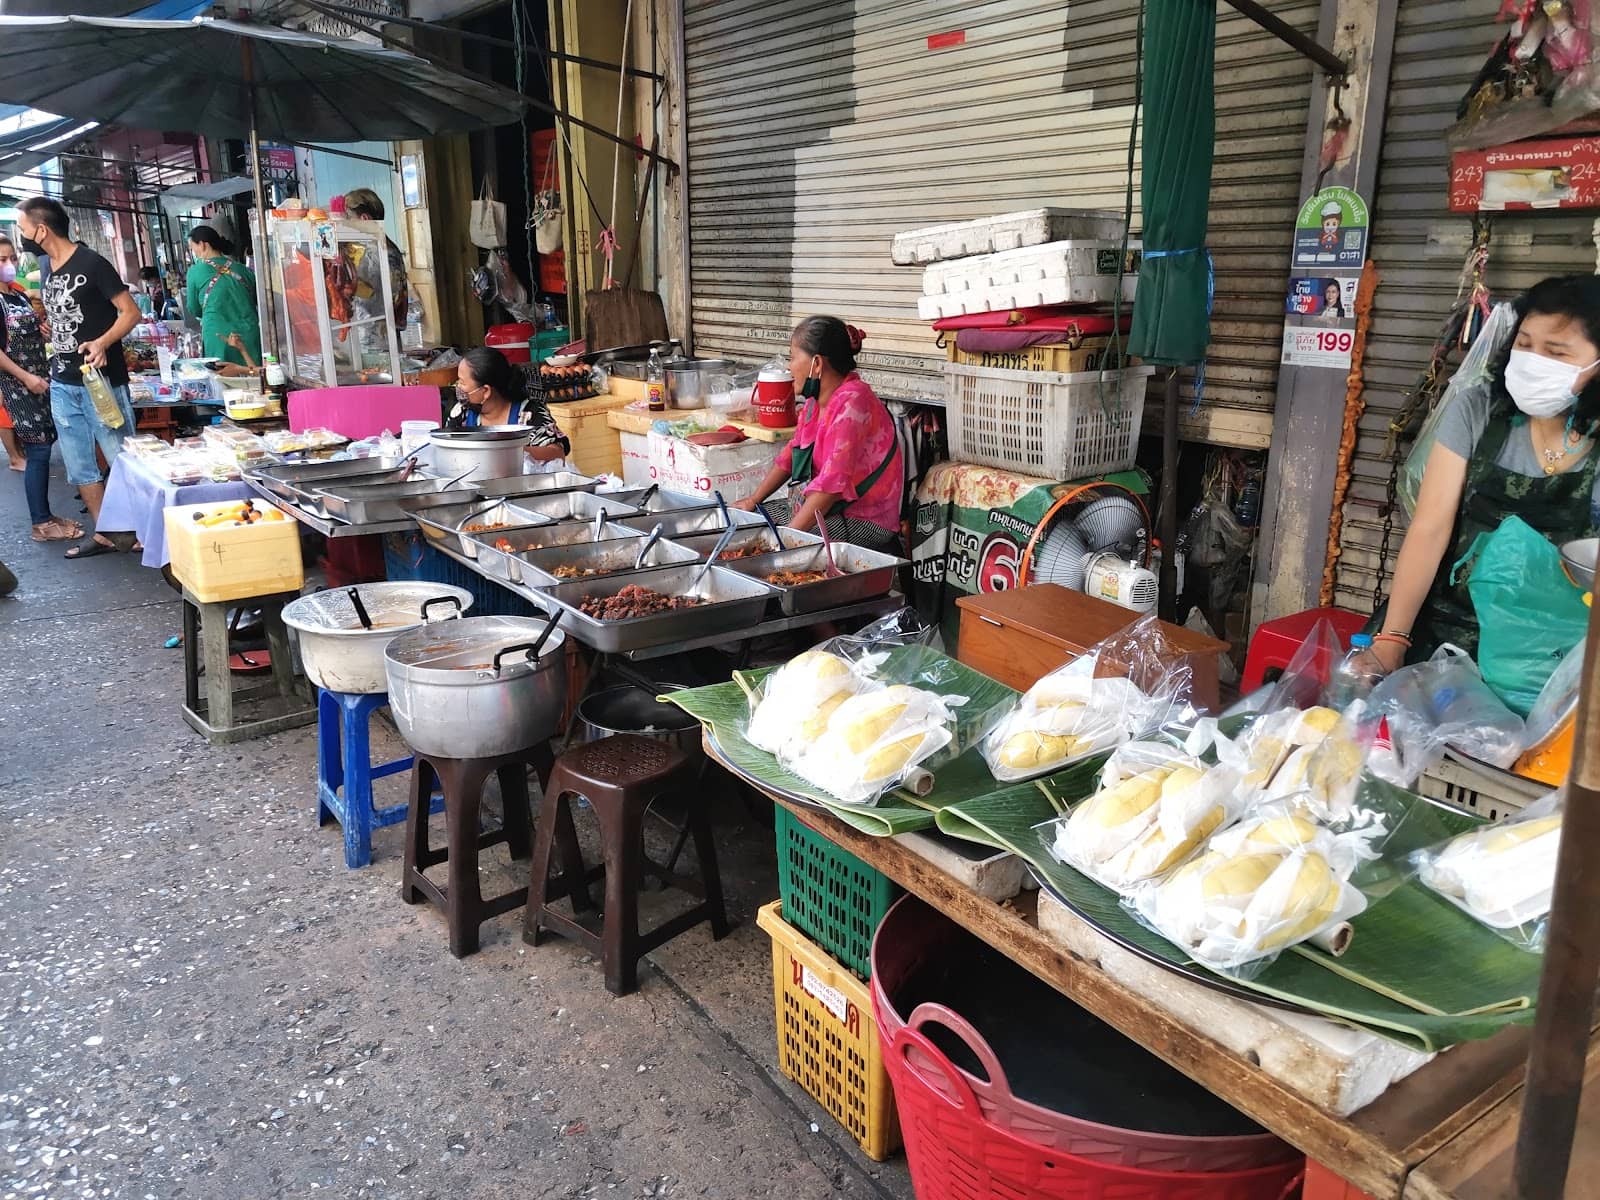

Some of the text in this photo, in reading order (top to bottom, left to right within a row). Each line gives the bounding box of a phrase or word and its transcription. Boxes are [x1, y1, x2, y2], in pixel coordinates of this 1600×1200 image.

[1454, 166, 1484, 183] 243
[1316, 332, 1351, 352] 199
[953, 532, 979, 551] บาท
[213, 541, 227, 566] 4
